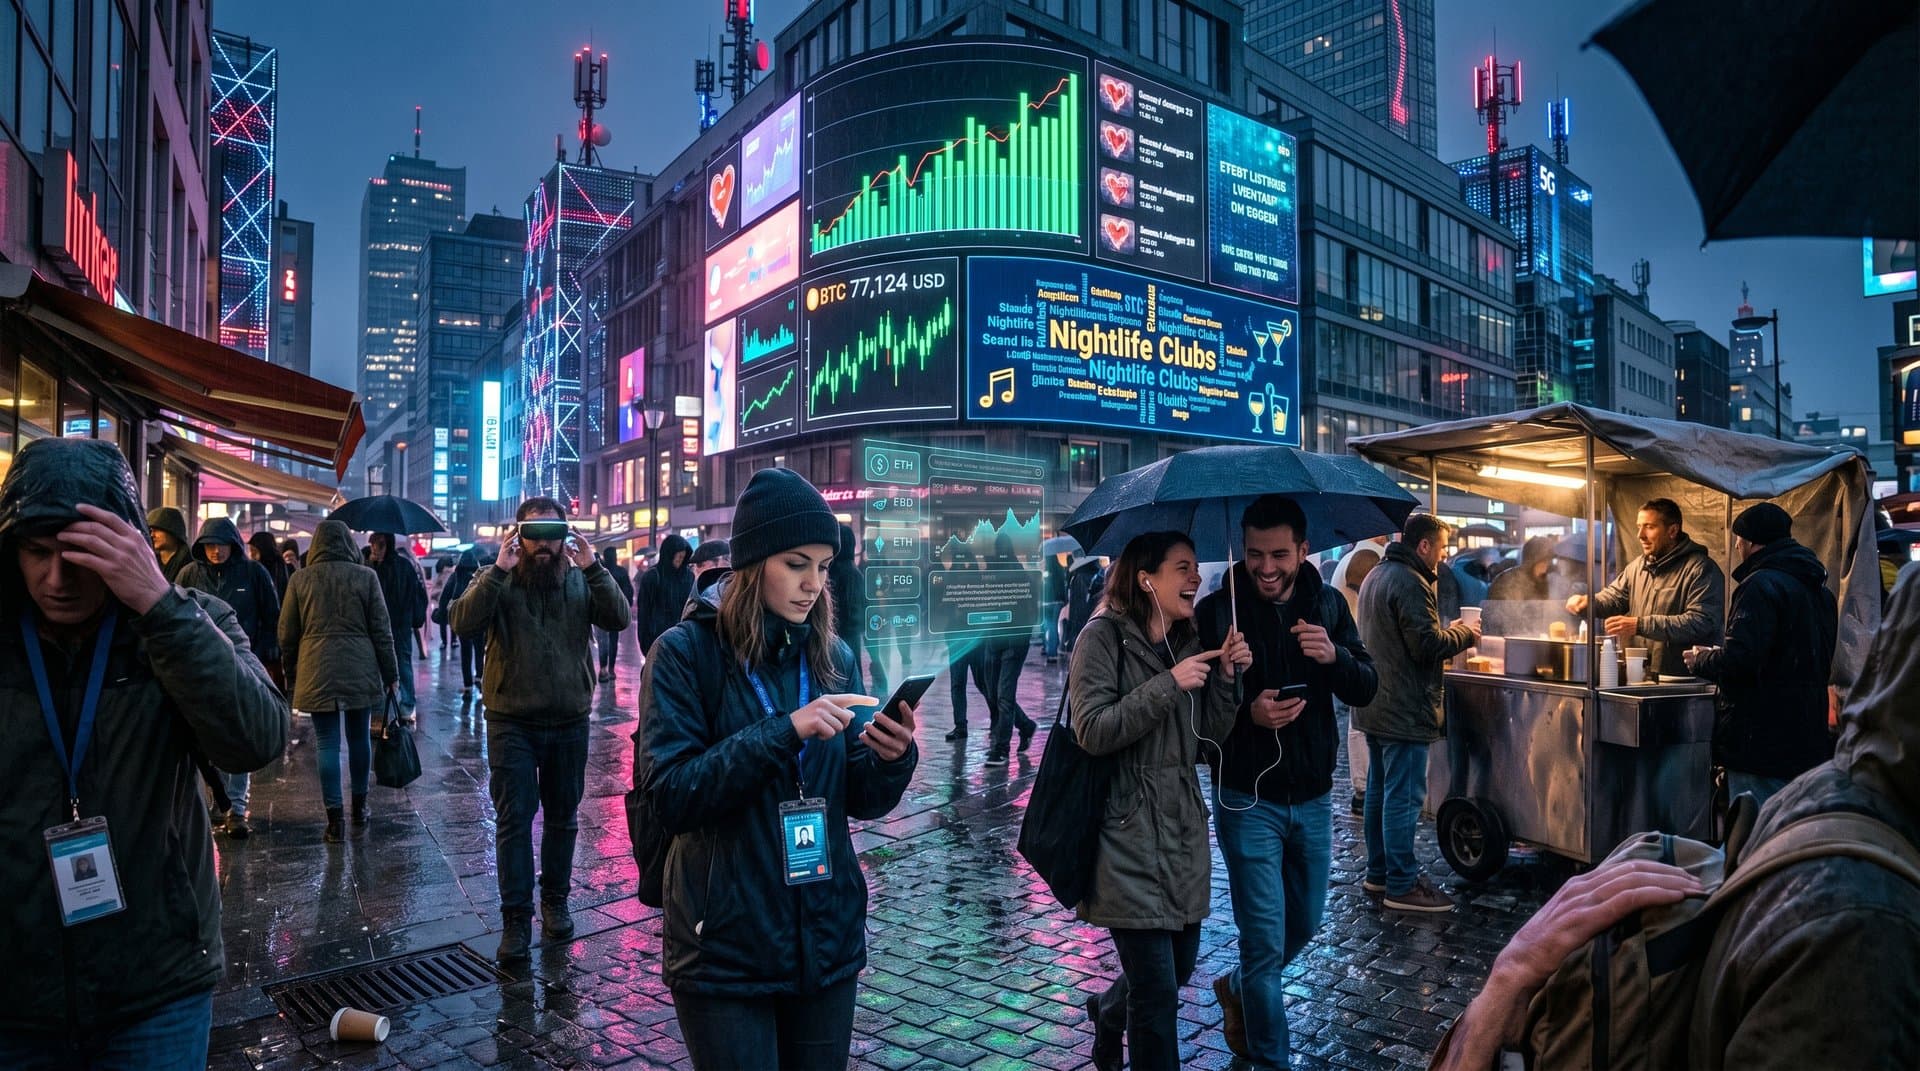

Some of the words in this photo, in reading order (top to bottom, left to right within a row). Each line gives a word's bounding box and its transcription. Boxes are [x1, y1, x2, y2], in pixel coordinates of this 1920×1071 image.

[1540, 165, 1555, 195] 5G
[820, 283, 847, 305] BTC
[850, 272, 908, 299] 77,124
[912, 273, 945, 289] USD
[987, 315, 1034, 331] Nightlife
[1050, 319, 1153, 361] Nightlife
[1159, 336, 1217, 371] Clubs
[1089, 359, 1155, 386] Nightlife
[1159, 368, 1199, 392] Clubs
[894, 459, 913, 471] ETH
[893, 537, 913, 548] ETH
[893, 575, 913, 586] FGG
